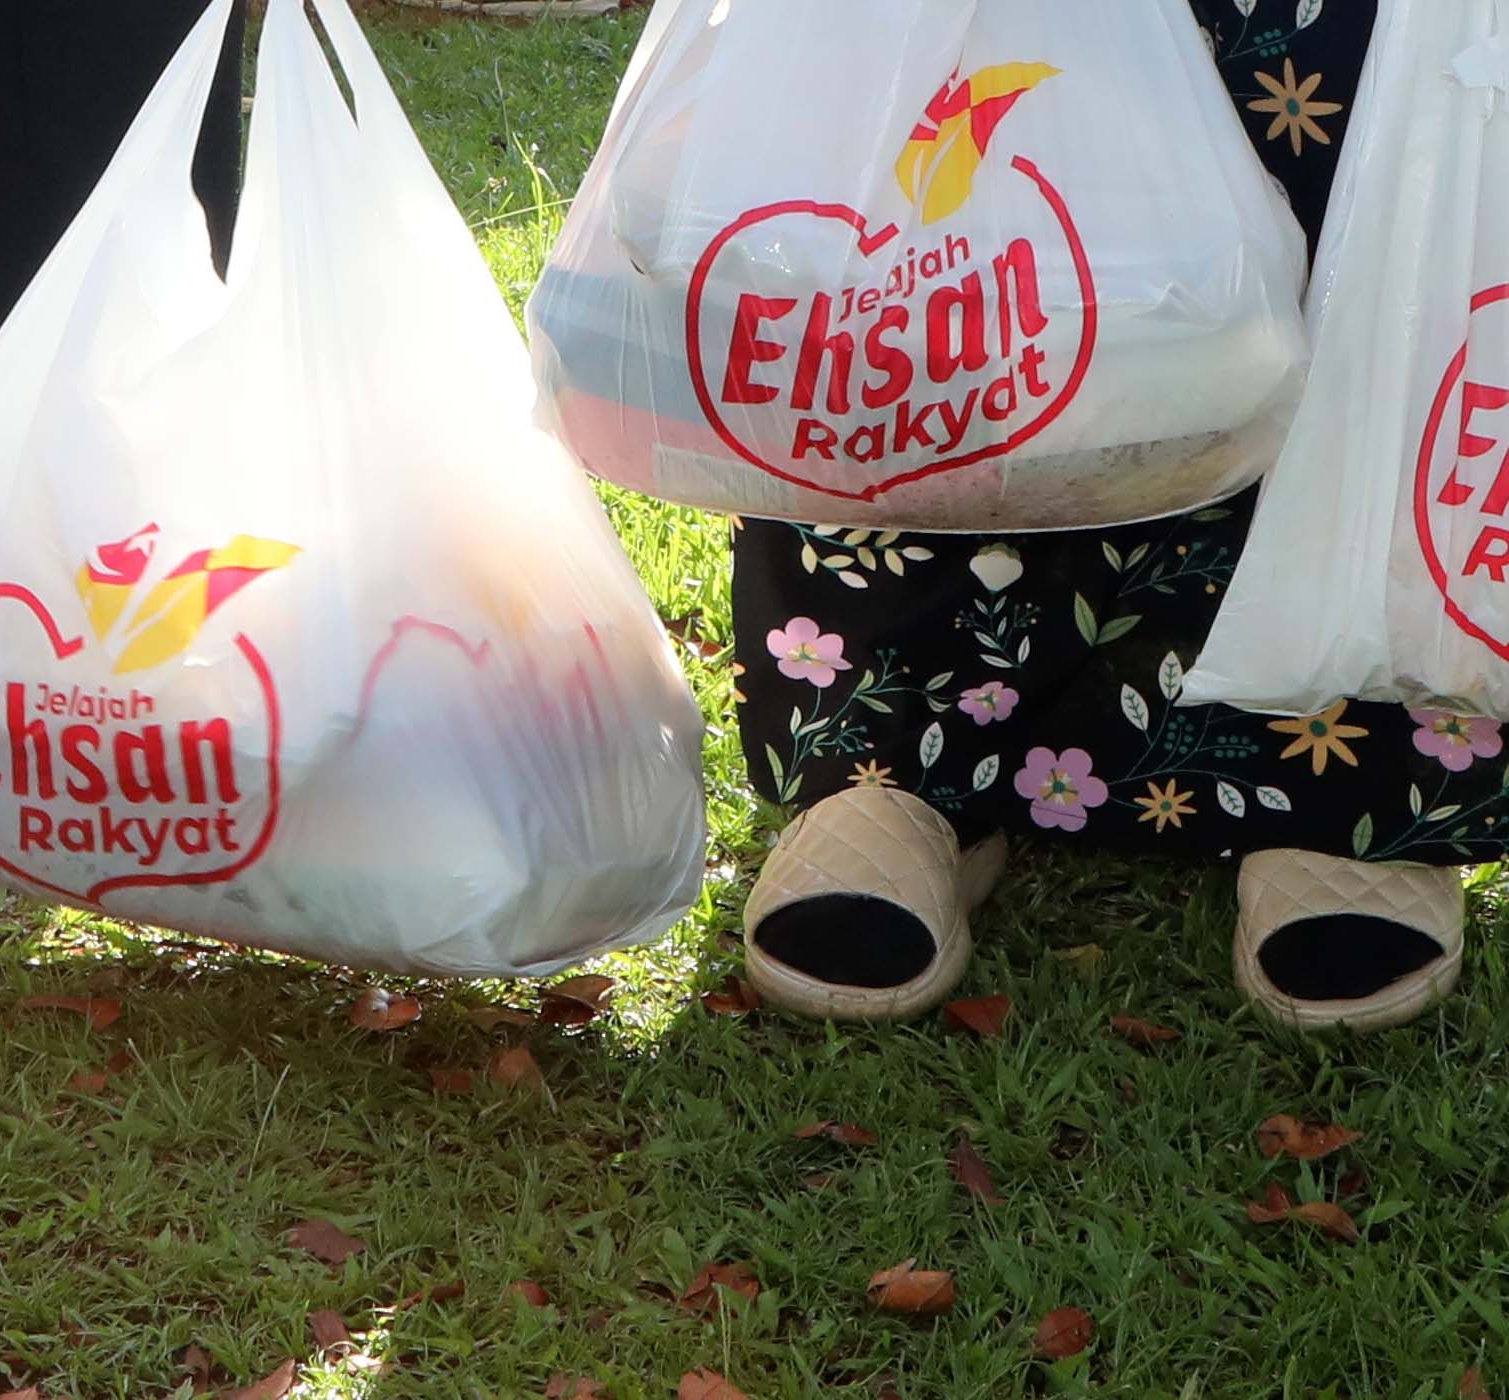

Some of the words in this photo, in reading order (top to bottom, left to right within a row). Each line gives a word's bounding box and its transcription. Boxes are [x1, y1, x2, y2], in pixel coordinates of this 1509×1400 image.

[721, 238, 1049, 416] Ehsan
[790, 343, 1051, 464] Rakyat
[35, 684, 155, 725] Jelajah
[19, 805, 240, 866] Rakyat
